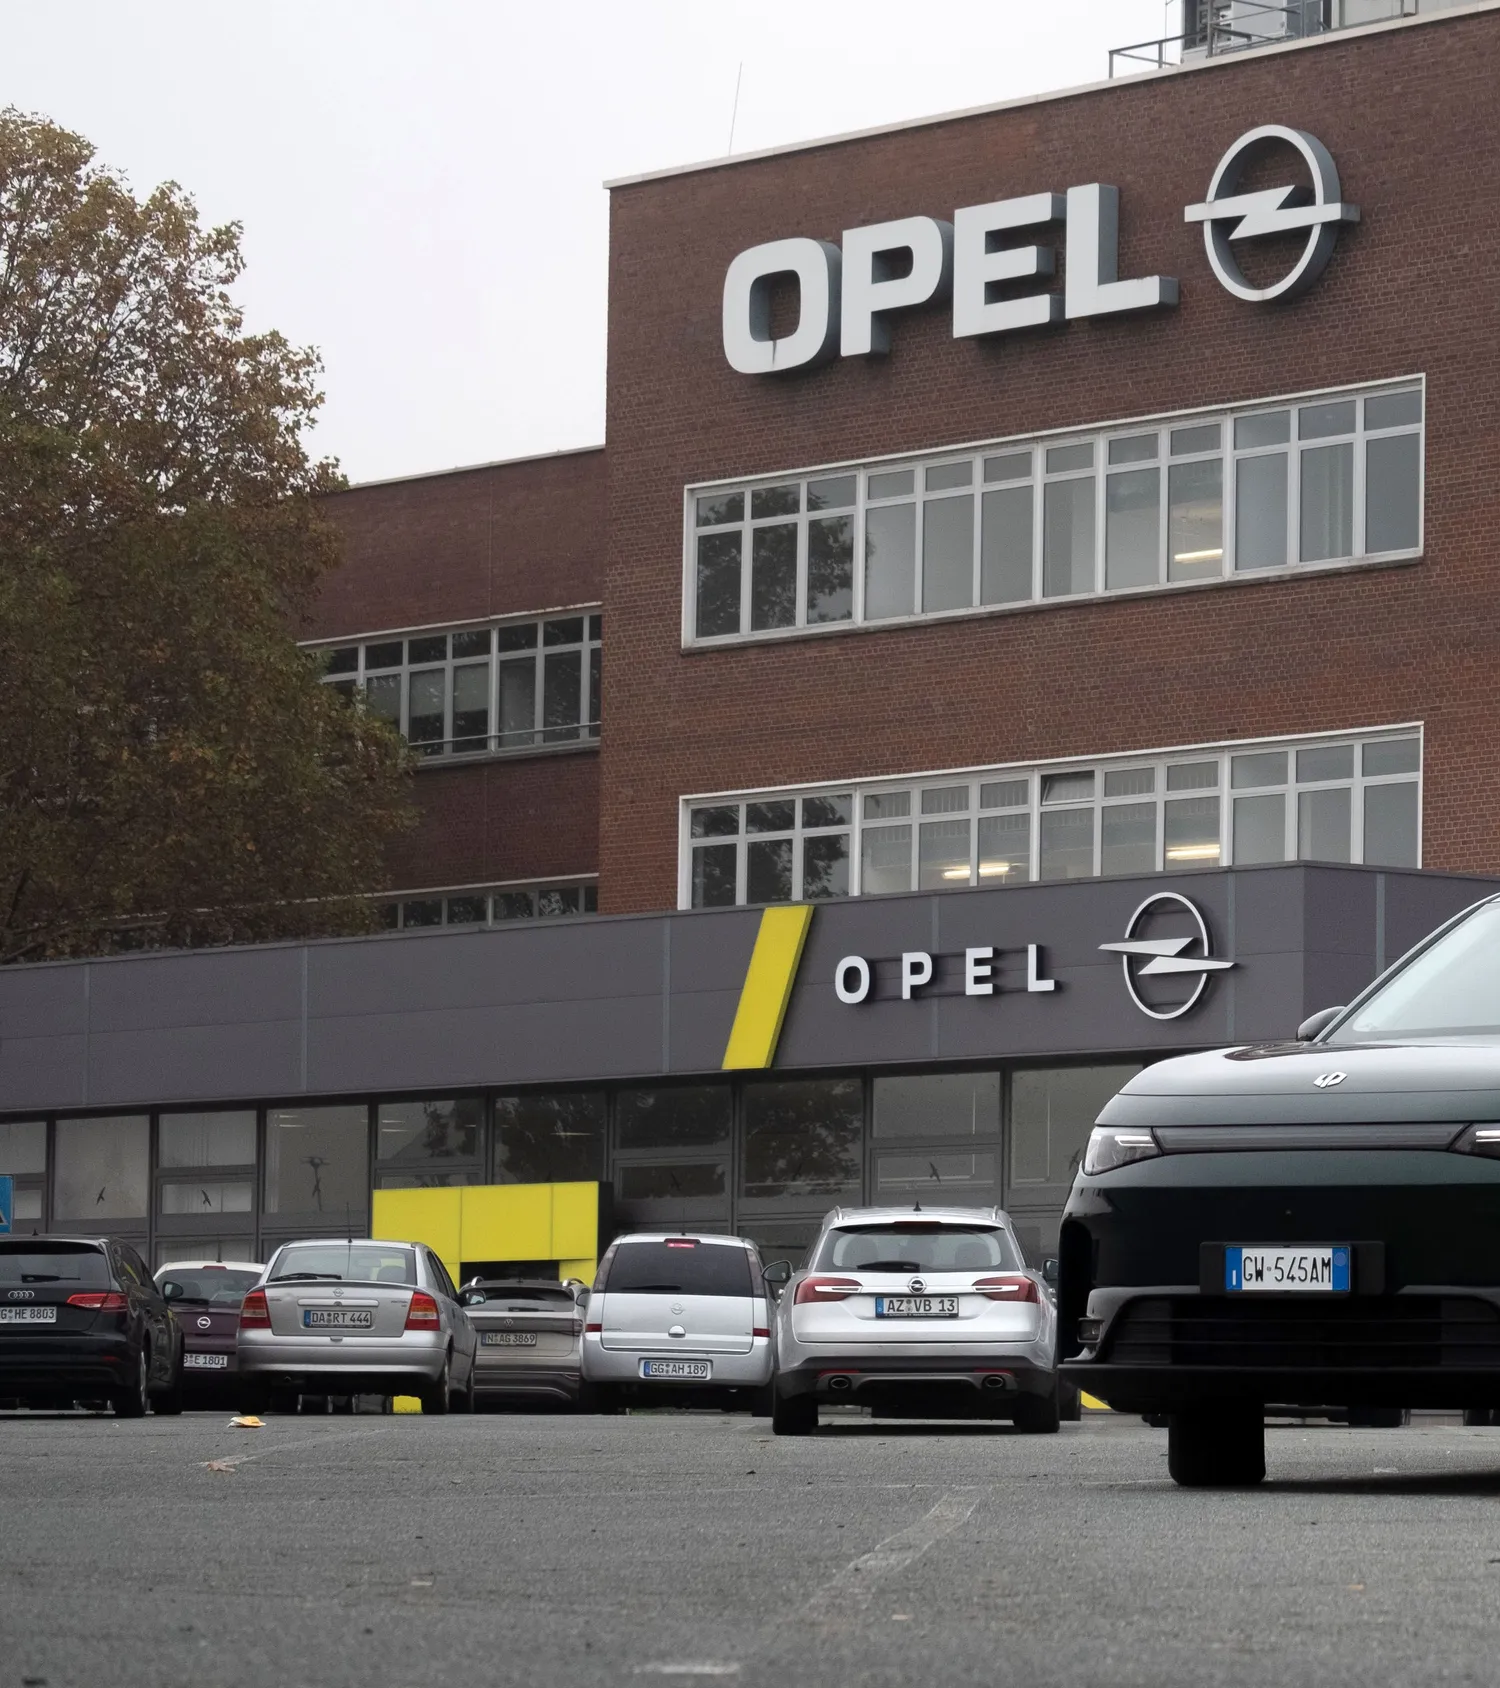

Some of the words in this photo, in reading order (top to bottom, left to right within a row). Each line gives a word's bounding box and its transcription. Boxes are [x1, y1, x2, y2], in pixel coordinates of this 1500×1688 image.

[722, 182, 1179, 374] OPEL
[834, 943, 1056, 1004] OPEL
[1243, 1256, 1265, 1282] GW
[1274, 1256, 1332, 1283] 545AM
[887, 1299, 905, 1312] AZ
[914, 1299, 932, 1312] VB
[938, 1299, 955, 1312] 13
[14, 1309, 28, 1320] HE
[29, 1308, 55, 1319] 8803
[312, 1312, 326, 1324] DA
[333, 1312, 348, 1324] RT
[350, 1312, 369, 1324] 444
[202, 1355, 226, 1366] 1801
[650, 1363, 665, 1374] GG
[671, 1364, 685, 1374] AH
[686, 1364, 706, 1375] 189
